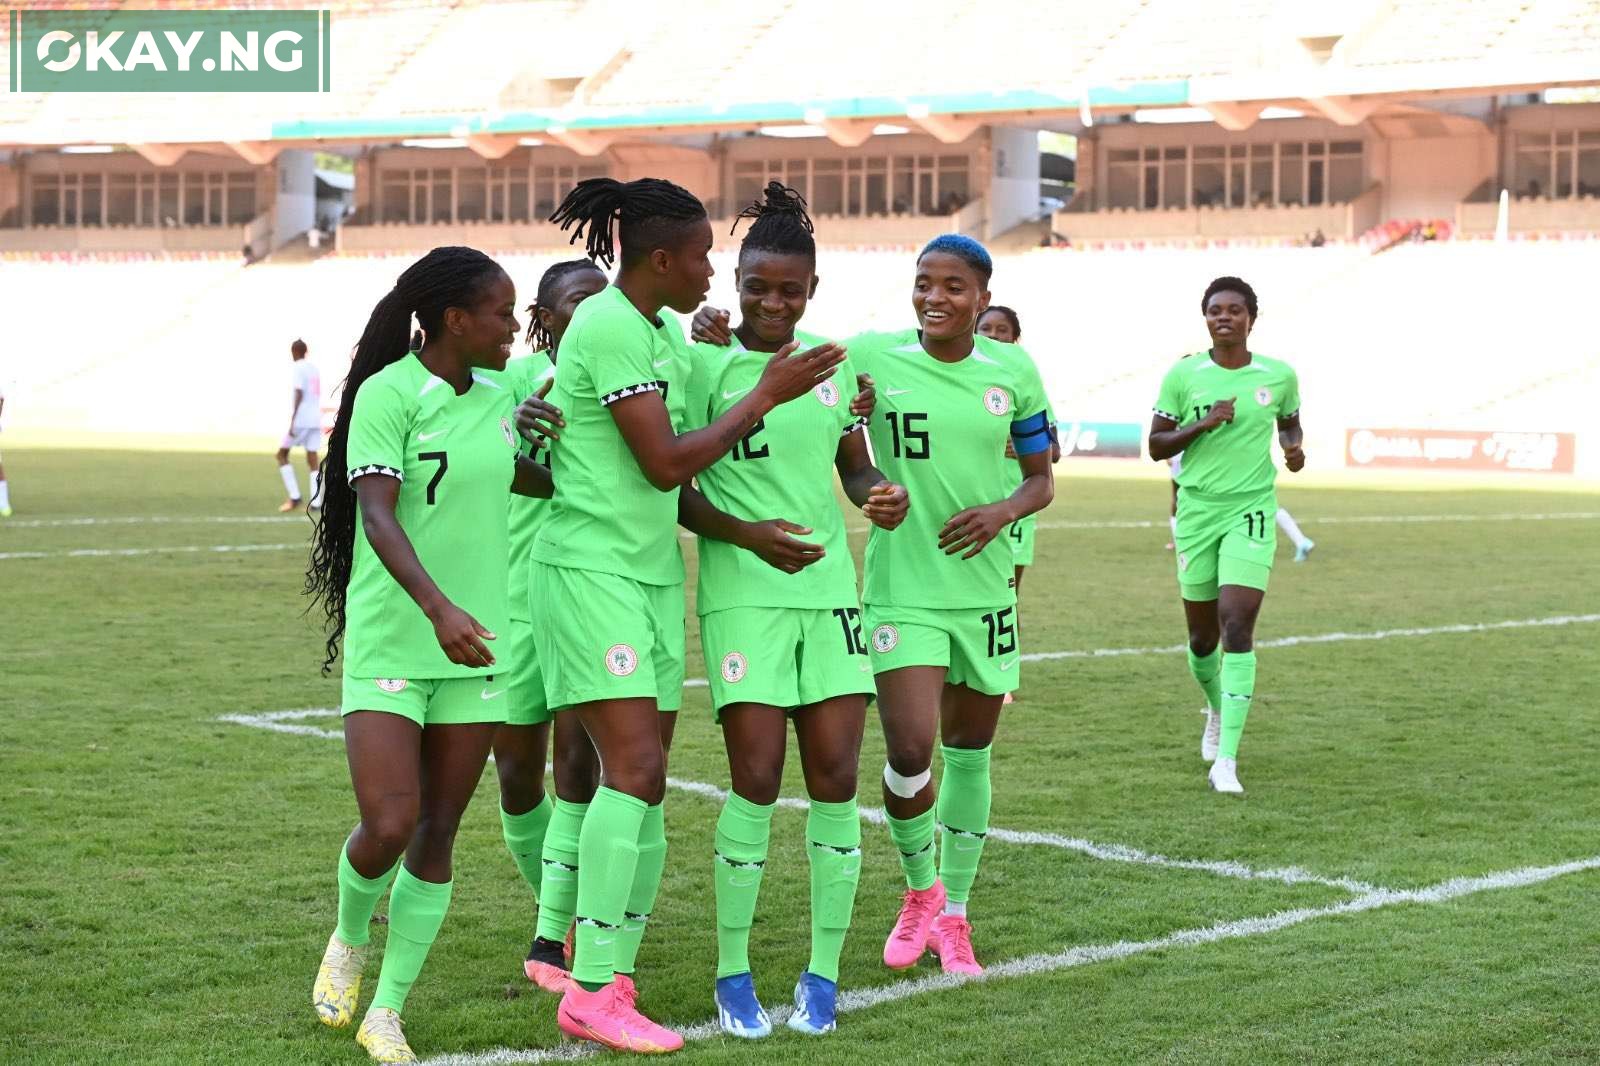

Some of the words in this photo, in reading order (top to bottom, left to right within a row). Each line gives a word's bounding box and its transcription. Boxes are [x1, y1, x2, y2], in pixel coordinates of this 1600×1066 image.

[886, 411, 930, 460] 15
[418, 451, 448, 505] 7
[1243, 510, 1265, 538] 11
[832, 607, 869, 656] 12
[981, 607, 1017, 657] 15
